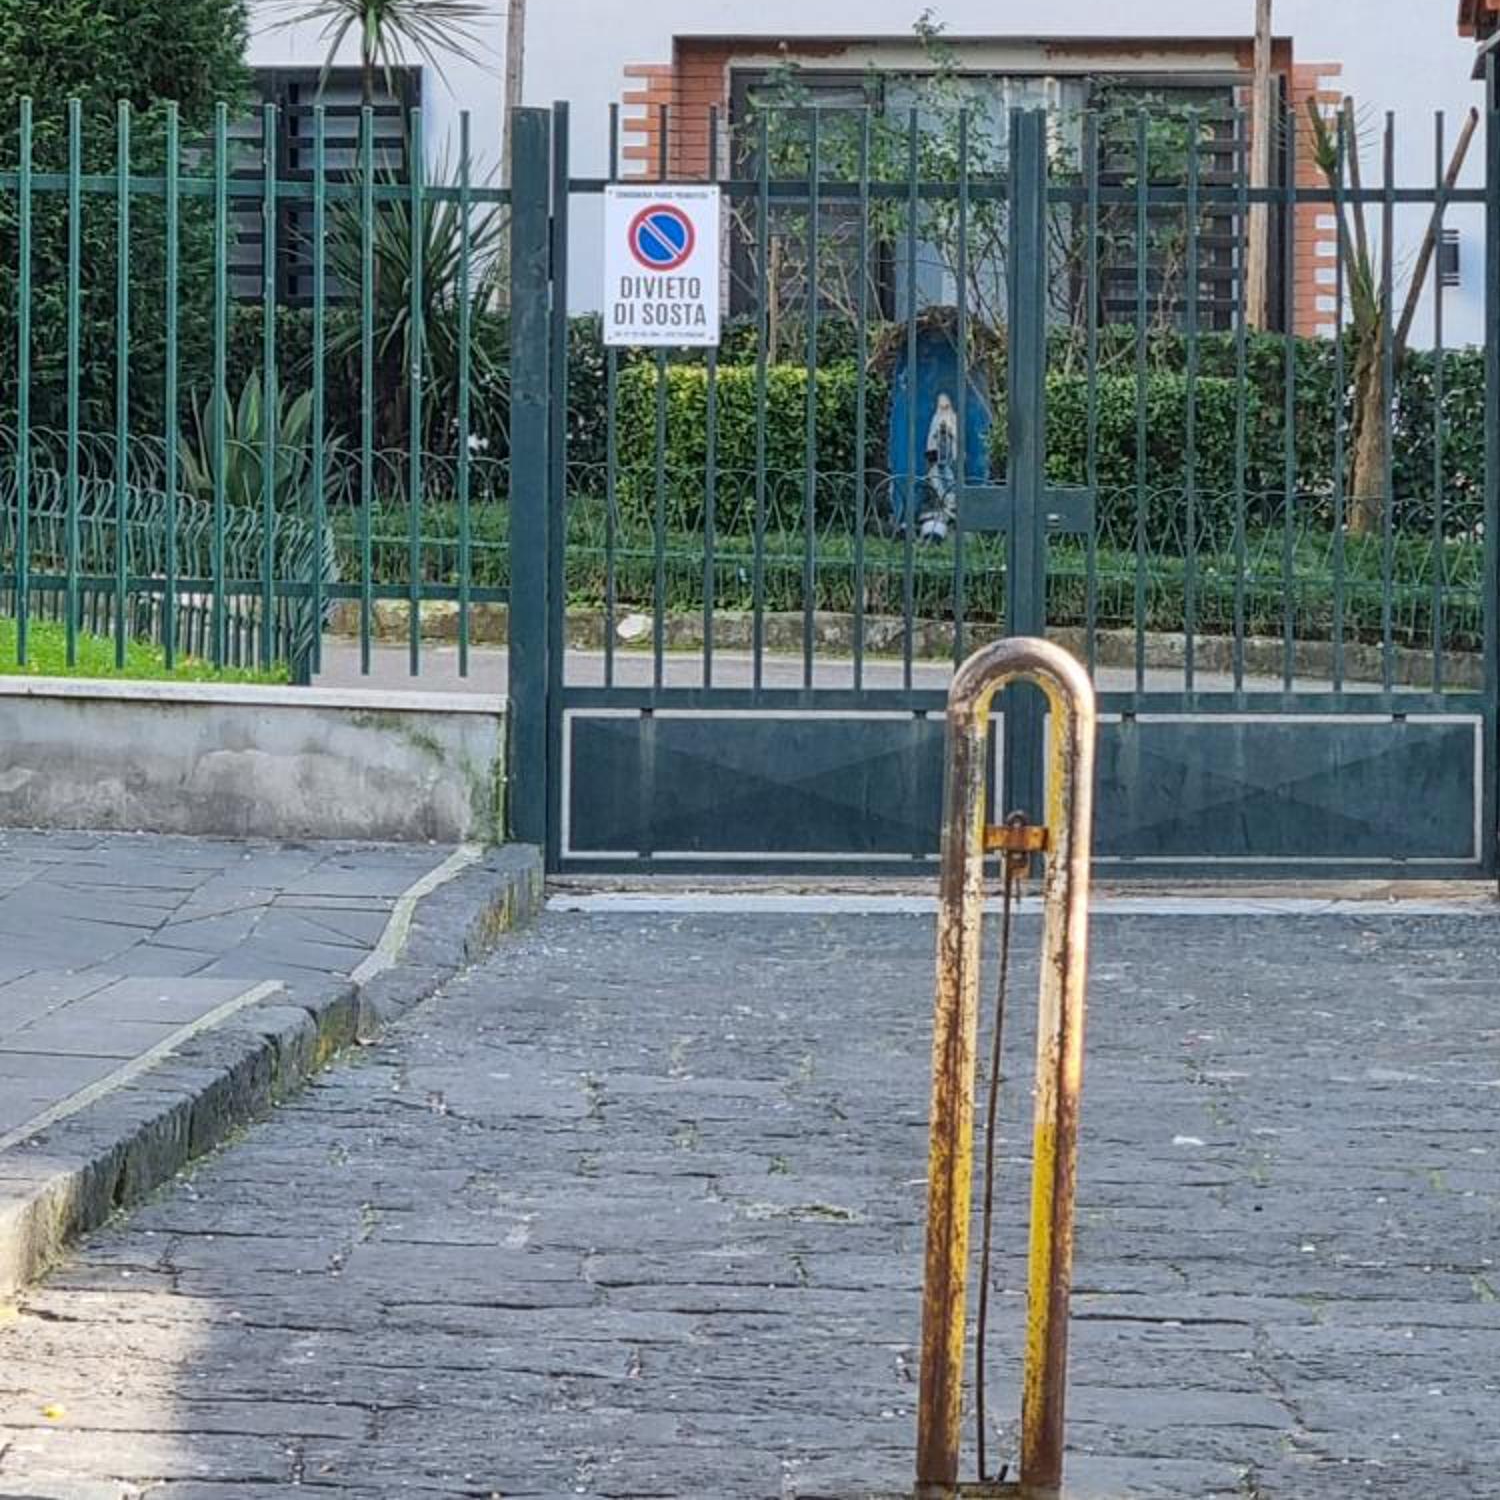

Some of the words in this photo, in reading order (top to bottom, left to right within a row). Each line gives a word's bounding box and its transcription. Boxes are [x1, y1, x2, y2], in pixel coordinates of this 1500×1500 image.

[620, 276, 701, 299] DIVIETO
[614, 303, 635, 325] DI
[642, 303, 707, 325] SOSTA
